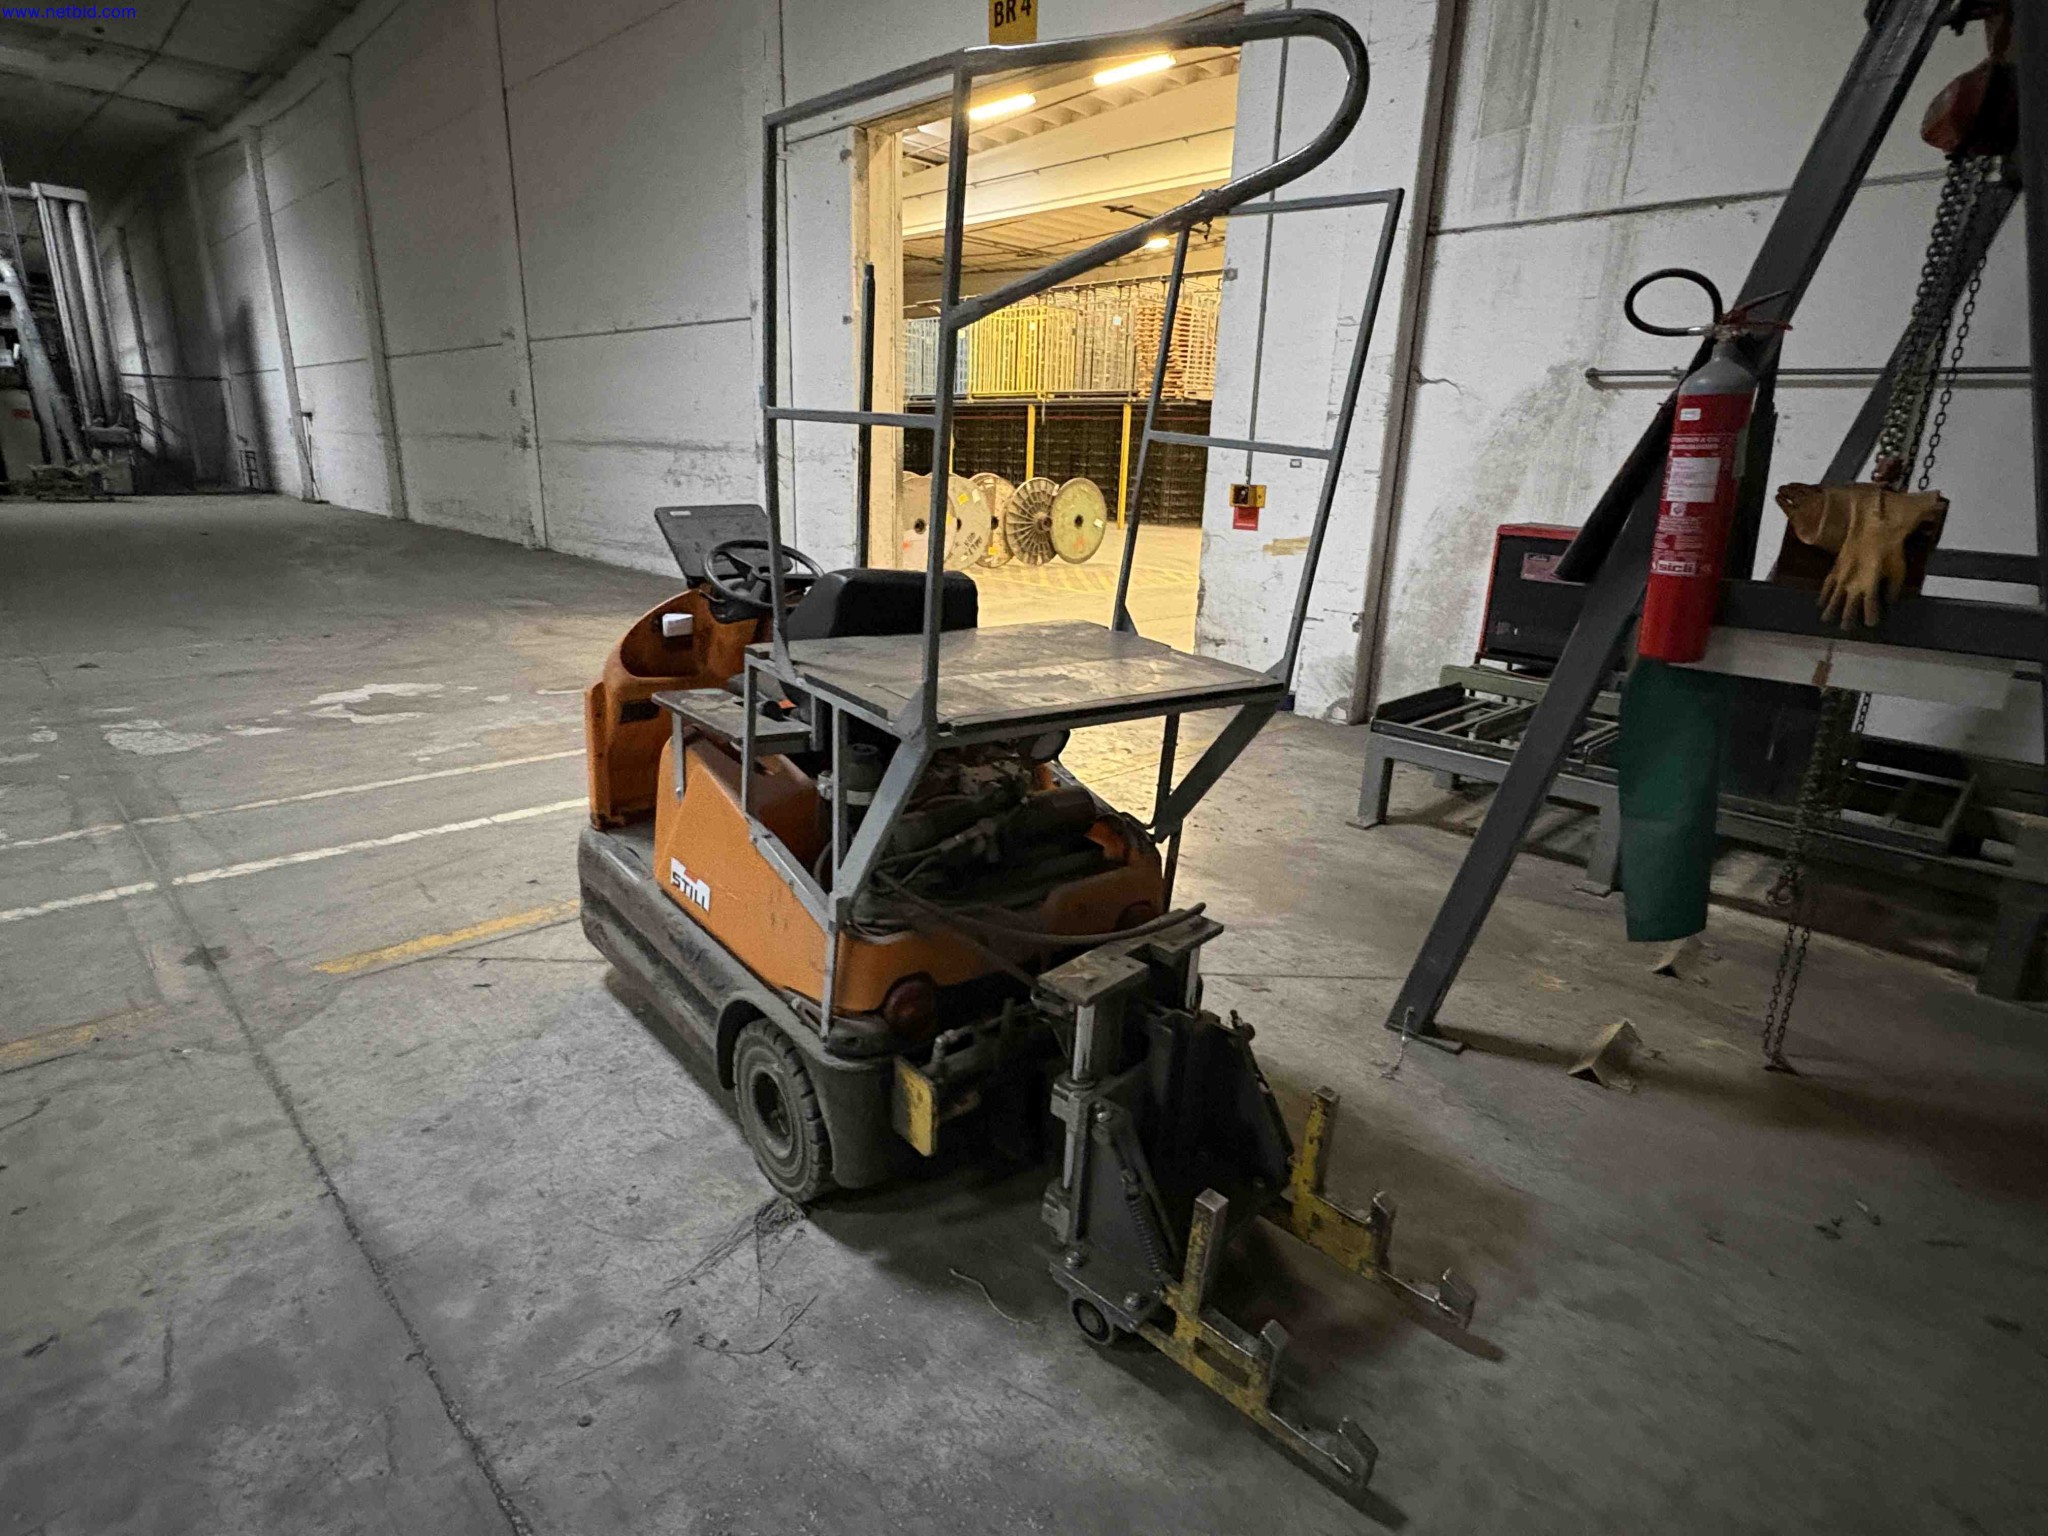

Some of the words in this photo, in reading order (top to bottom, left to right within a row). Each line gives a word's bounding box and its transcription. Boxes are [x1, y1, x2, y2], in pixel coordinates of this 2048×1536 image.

[993, 0, 1017, 28] BR
[1020, 0, 1032, 17] 4
[672, 871, 709, 913] STILL
